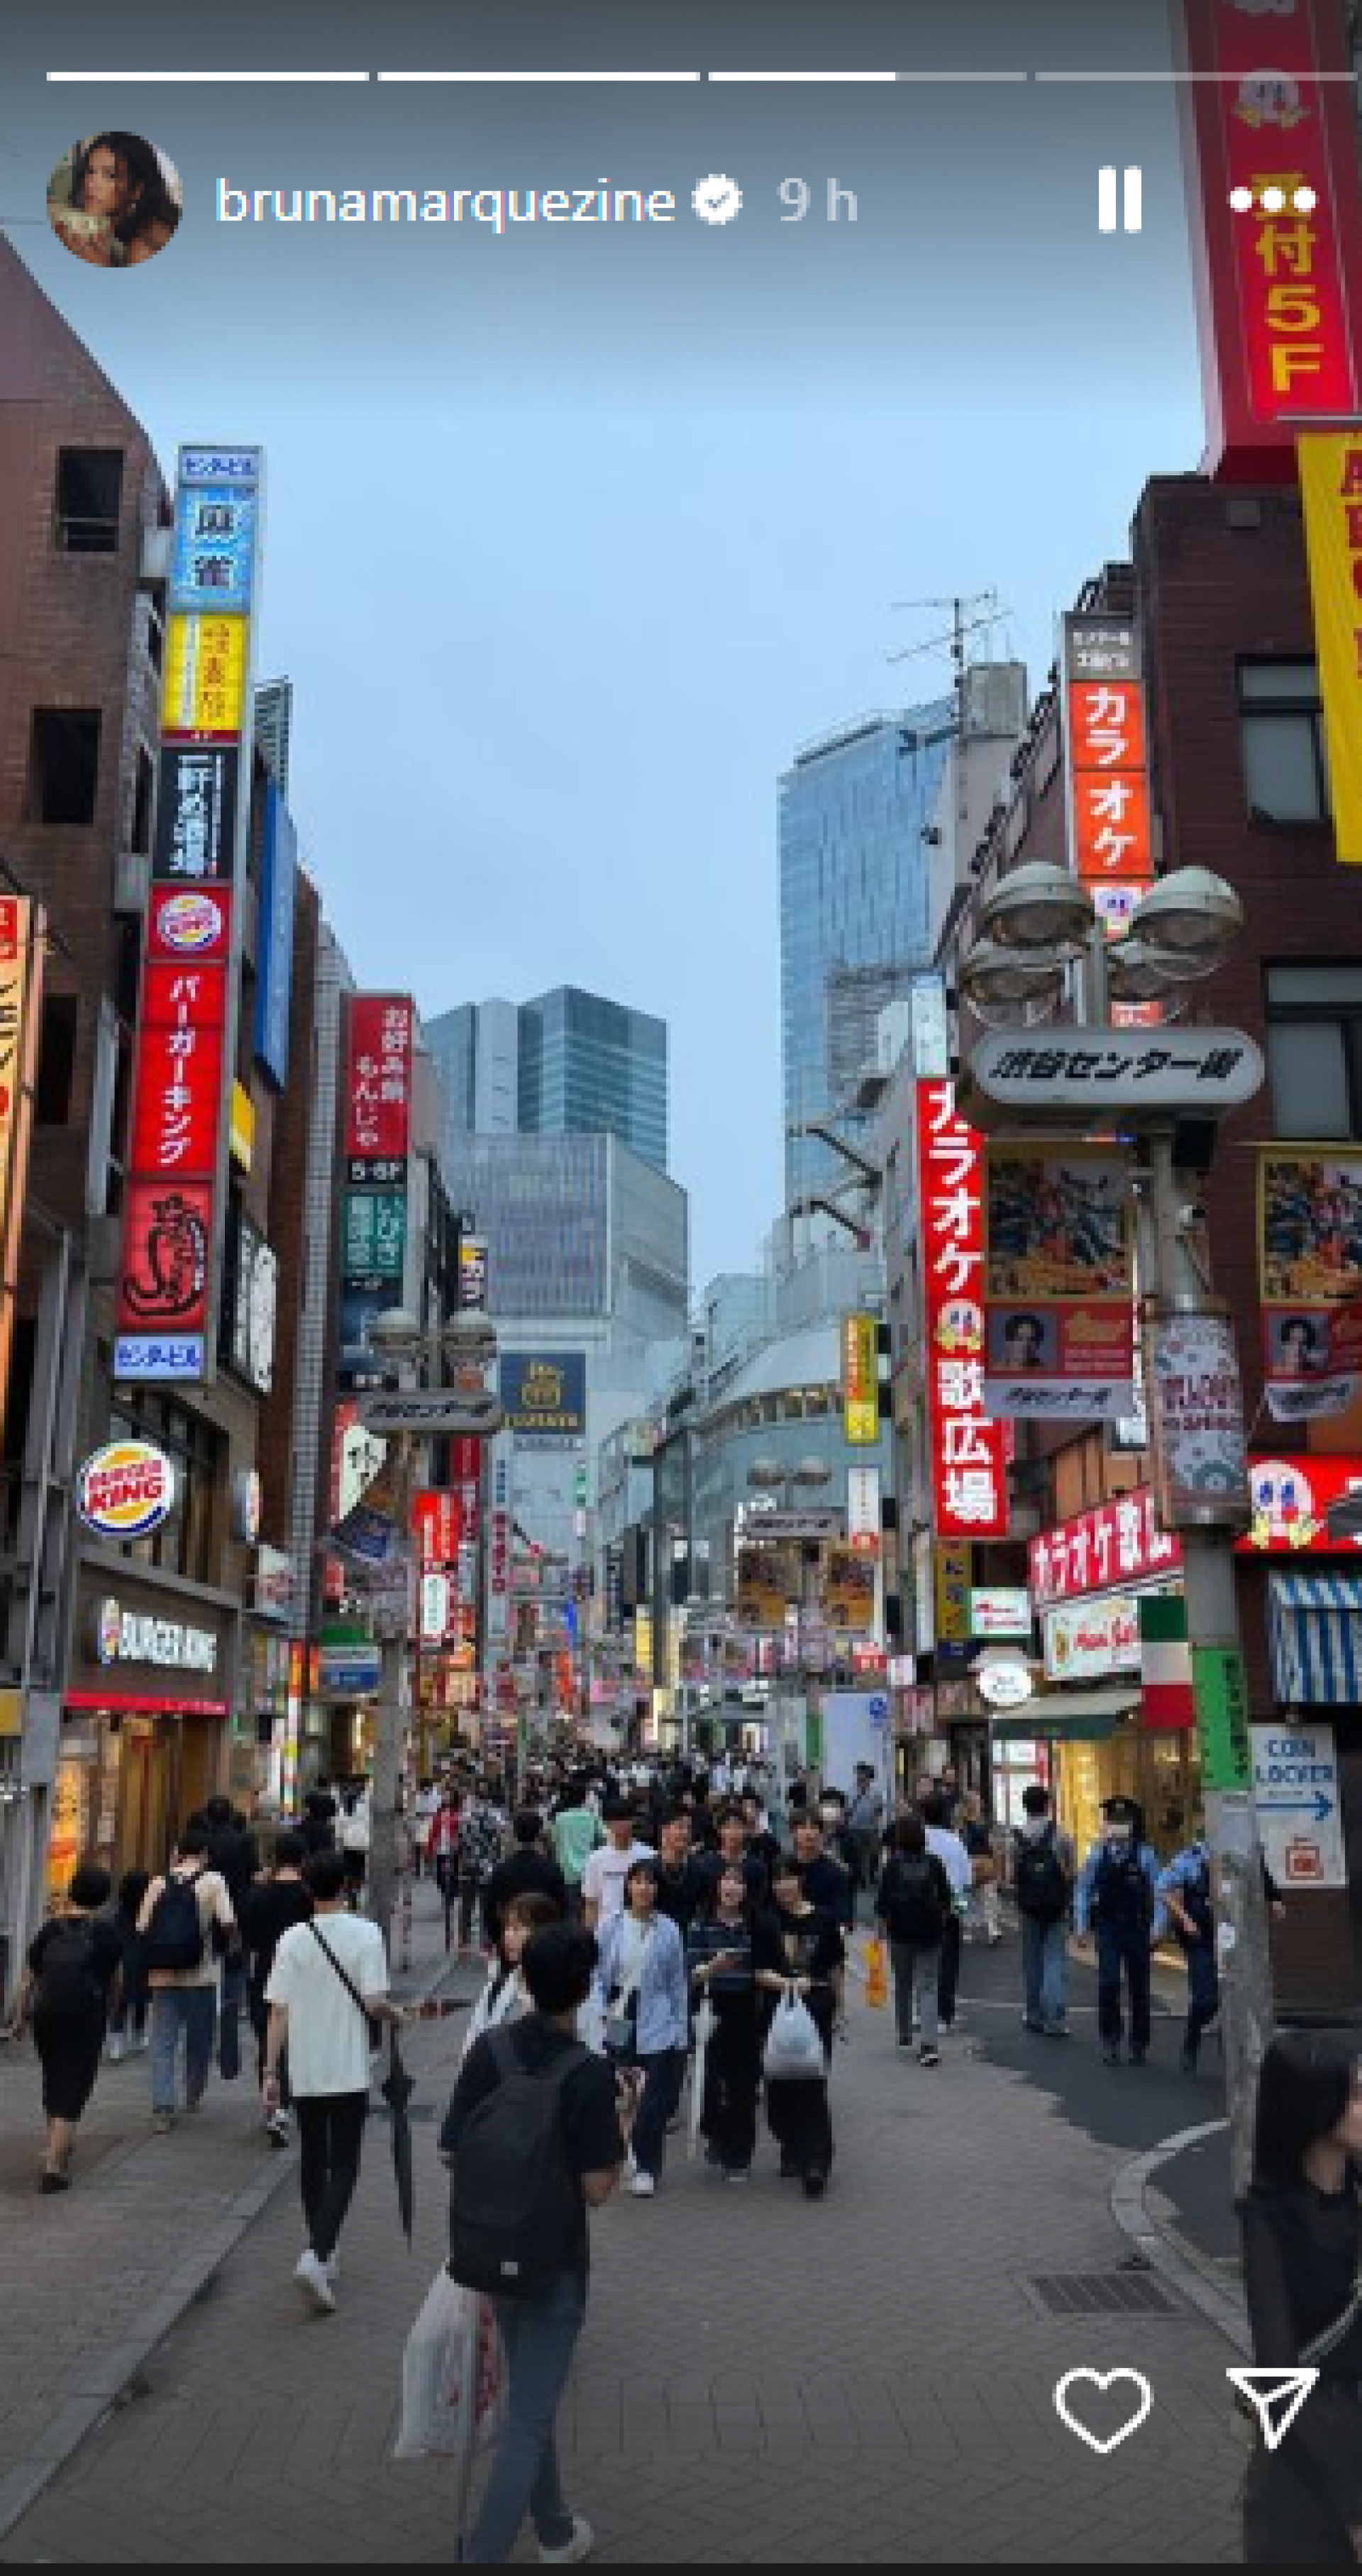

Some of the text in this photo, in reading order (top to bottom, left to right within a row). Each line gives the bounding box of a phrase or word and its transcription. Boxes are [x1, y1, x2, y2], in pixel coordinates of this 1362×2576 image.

[1085, 687, 1136, 867] カラオケ
[159, 976, 201, 1164] バーガーキング
[990, 1050, 1241, 1081] 渋谷センター街
[88, 1459, 163, 1487] BURGER
[86, 1480, 164, 1511] KING
[1256, 1764, 1334, 1783] LOCKER
